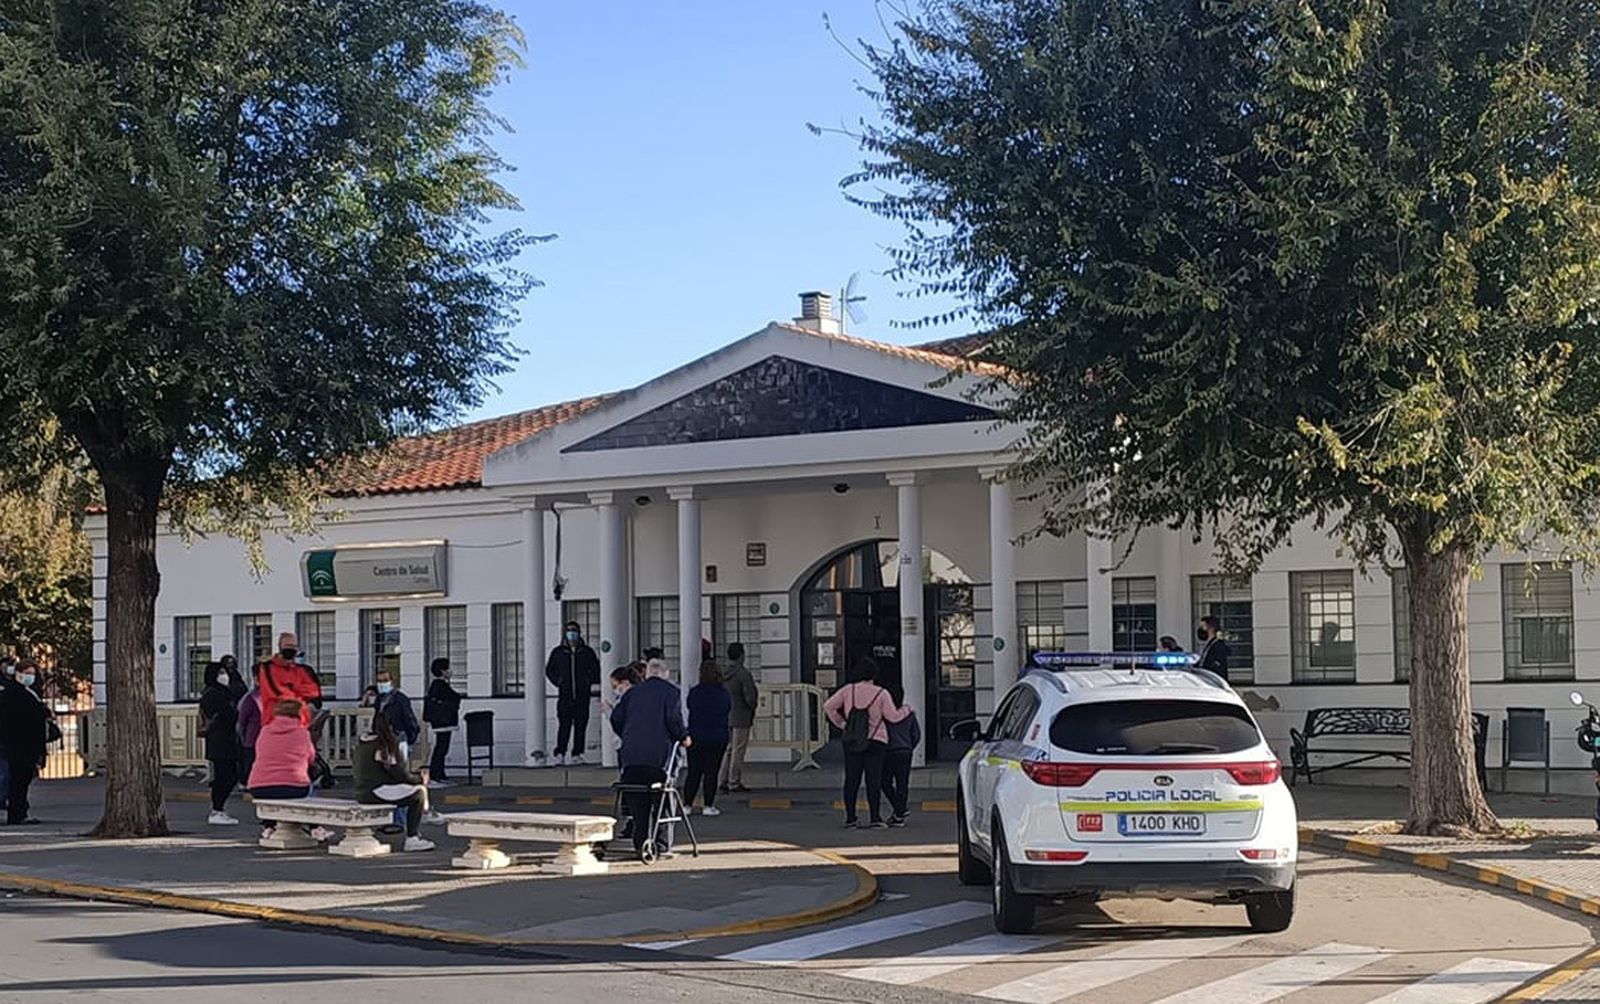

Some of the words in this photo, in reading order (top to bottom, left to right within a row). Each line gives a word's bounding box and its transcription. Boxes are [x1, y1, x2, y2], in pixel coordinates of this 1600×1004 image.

[373, 566, 397, 576] Centro
[399, 566, 407, 575] de
[409, 564, 429, 575] Salud
[1105, 790, 1166, 801] POLICIA
[1170, 790, 1222, 801] LOCAL
[1131, 815, 1166, 830] 1400
[1172, 815, 1200, 830] KHD
